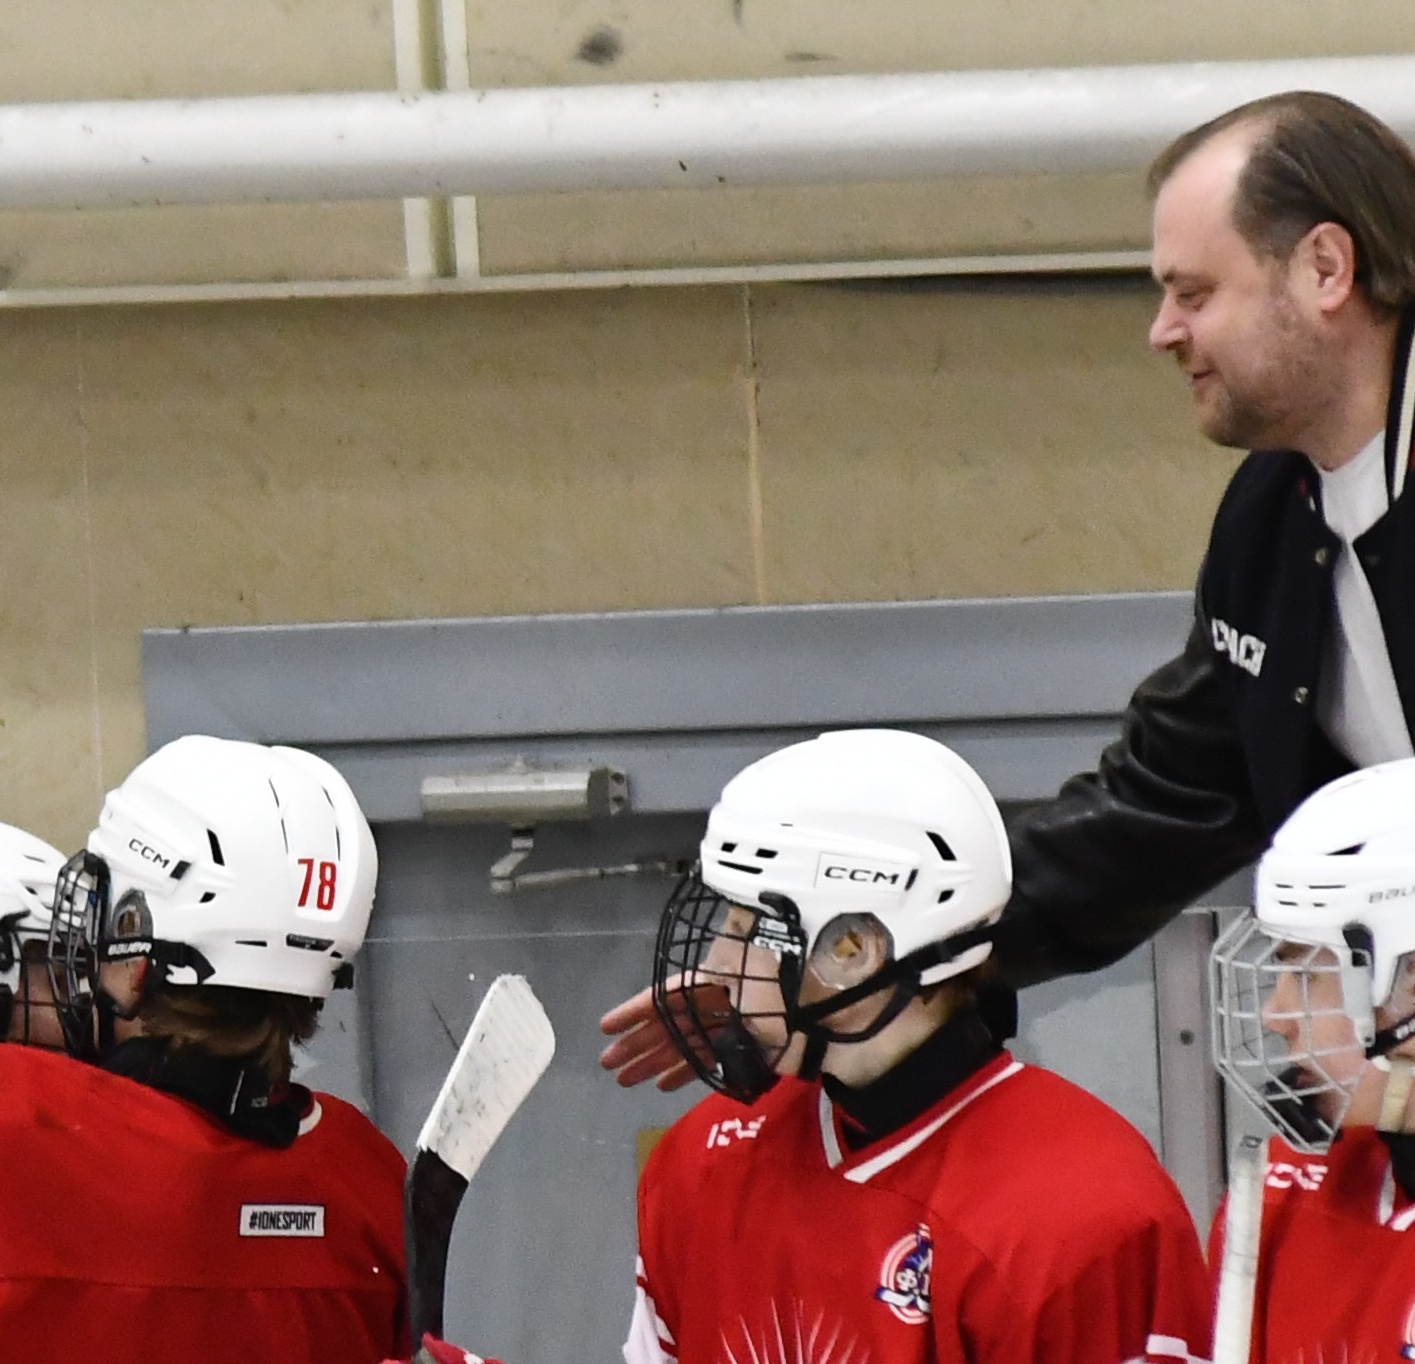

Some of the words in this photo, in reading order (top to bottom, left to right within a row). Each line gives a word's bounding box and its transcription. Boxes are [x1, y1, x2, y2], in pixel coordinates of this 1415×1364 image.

[127, 837, 170, 869] CCM
[297, 857, 338, 911] 78
[823, 864, 900, 886] CCM
